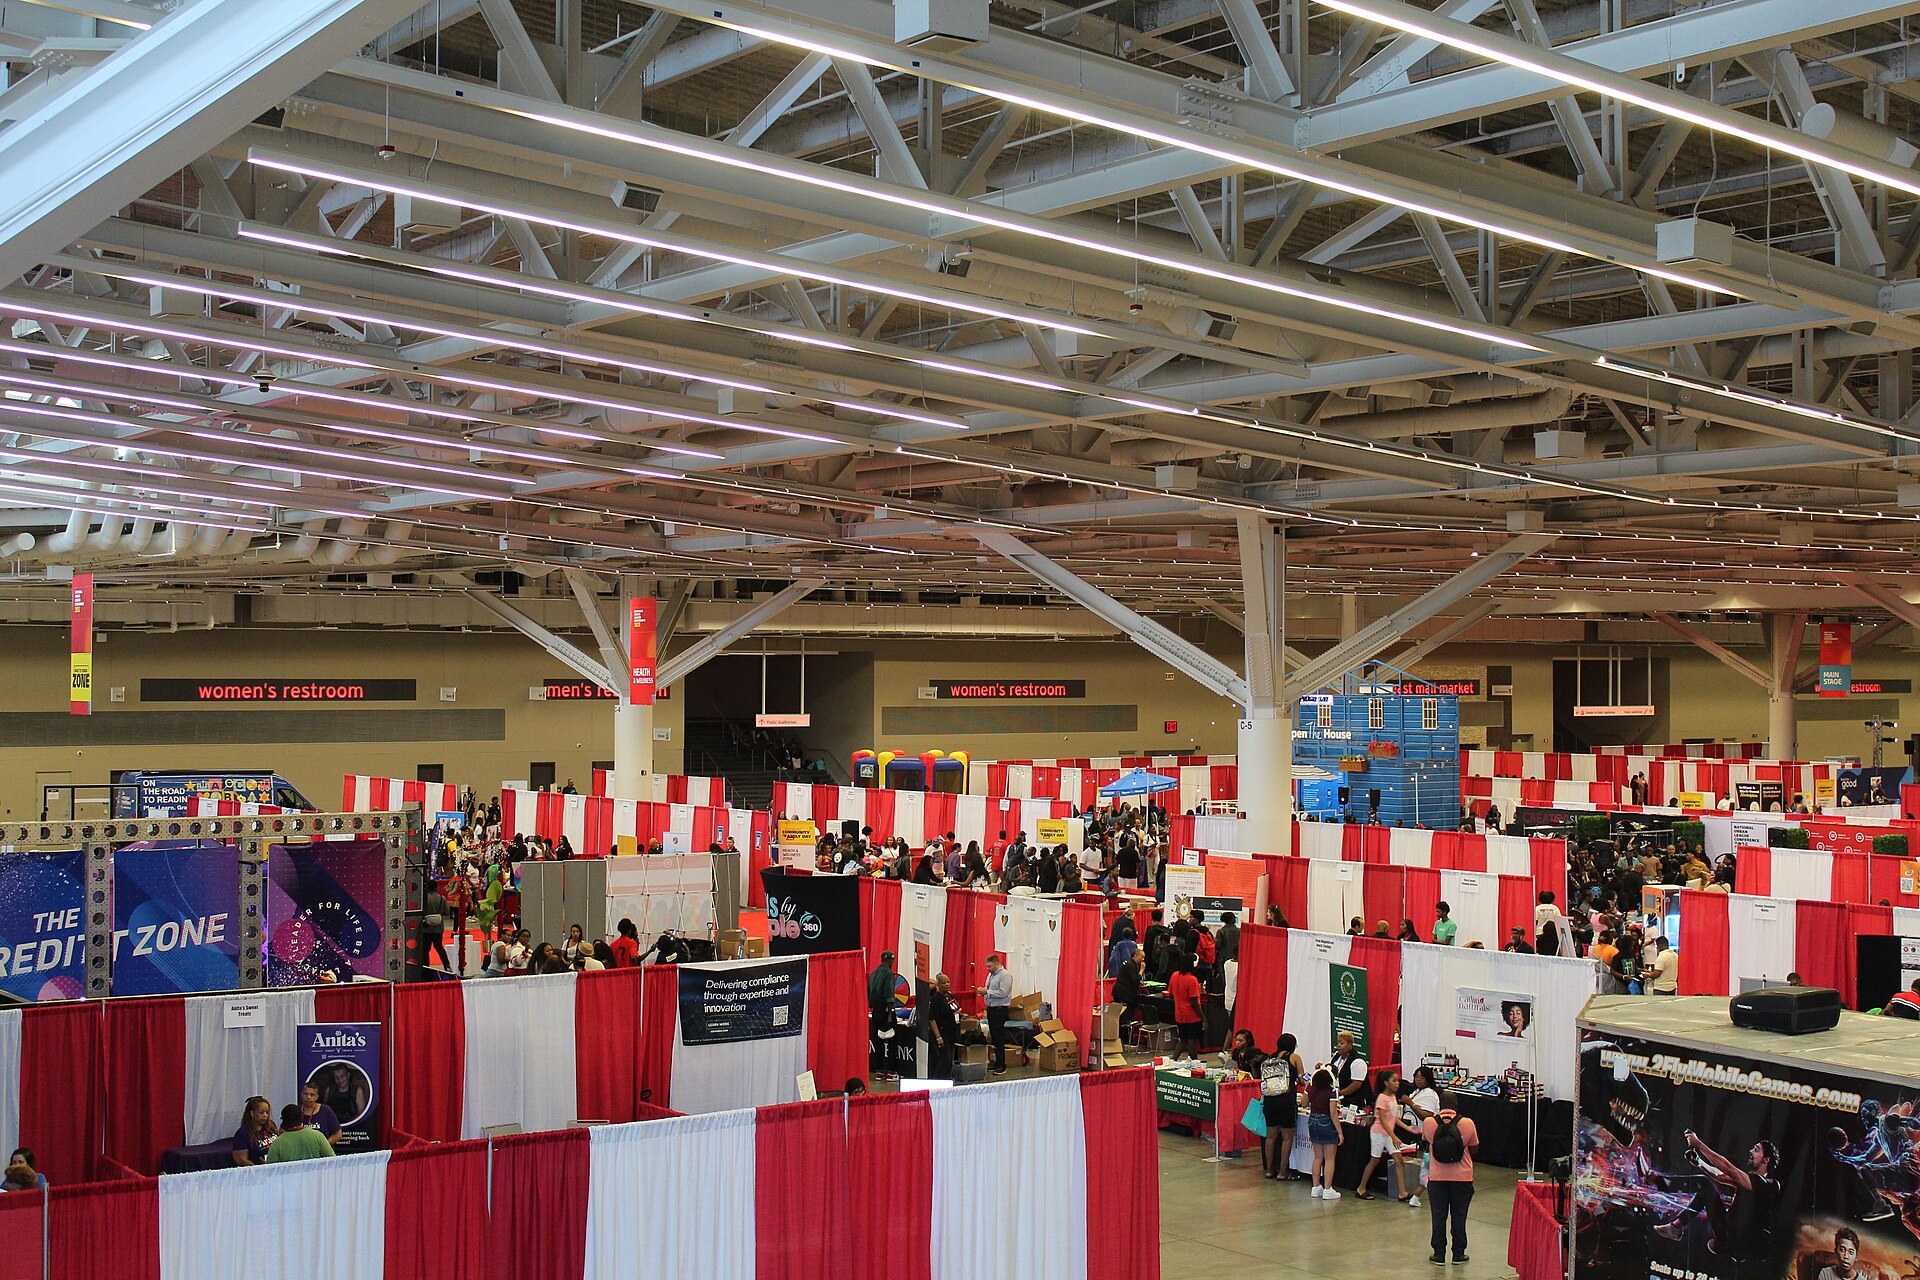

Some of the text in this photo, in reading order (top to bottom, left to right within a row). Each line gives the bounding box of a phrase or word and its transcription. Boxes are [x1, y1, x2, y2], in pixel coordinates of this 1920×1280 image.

[632, 667, 651, 677] HEALTH
[72, 673, 90, 688] ZONE
[1439, 680, 1475, 695] market
[1850, 682, 1881, 693] estroom
[198, 682, 364, 699] women's restroom
[546, 682, 593, 698] men's
[950, 682, 1066, 698] women's restroom
[1240, 721, 1253, 730] C-5
[1291, 730, 1308, 741] pen
[1323, 728, 1352, 740] House
[142, 779, 156, 787] ON
[1841, 779, 1857, 790] good
[142, 787, 186, 795] THE ROAD
[142, 795, 188, 804] TO READIN
[780, 896, 797, 922] by
[32, 906, 81, 934] THE
[291, 907, 314, 953] LEADER
[318, 901, 341, 911] FOR
[344, 908, 363, 934] LIFE
[132, 912, 229, 957] ZONE
[802, 923, 819, 932] 360
[705, 973, 790, 990] Delivering compliance
[703, 982, 790, 1003] through expertise and
[703, 1003, 747, 1014] innovation
[1458, 1003, 1491, 1013] naturals
[311, 1030, 367, 1048] Anita's
[1159, 1080, 1178, 1088] CONTACT
[1168, 1088, 1182, 1096] EUCLID
[1649, 1260, 1672, 1275] Seats
[1672, 1267, 1684, 1280] up
[1685, 1269, 1695, 1280] to
